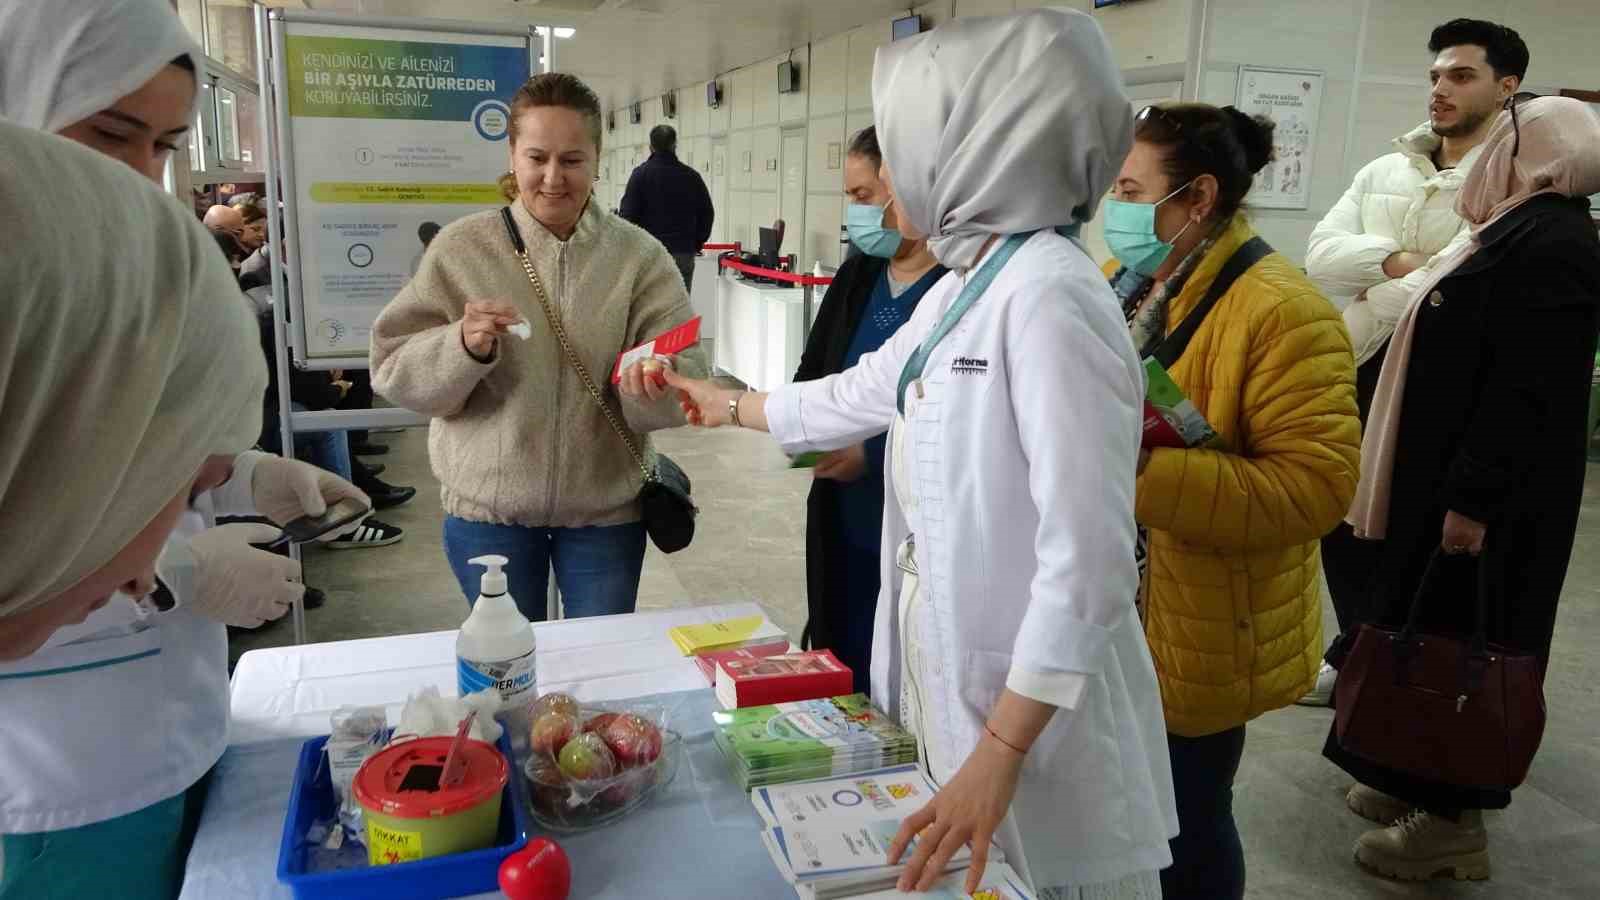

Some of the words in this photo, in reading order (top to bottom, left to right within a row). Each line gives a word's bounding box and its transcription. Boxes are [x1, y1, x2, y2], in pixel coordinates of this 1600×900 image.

[303, 52, 374, 70] KENDİNİZİ
[378, 56, 395, 70] VE
[401, 55, 454, 73] AİLENİZİ
[304, 71, 331, 84] BİR
[335, 73, 393, 89] AŞIYLA
[397, 73, 496, 92] ZATÜRREDEN
[305, 88, 433, 107] KORUYABİLİRSİNİZ.
